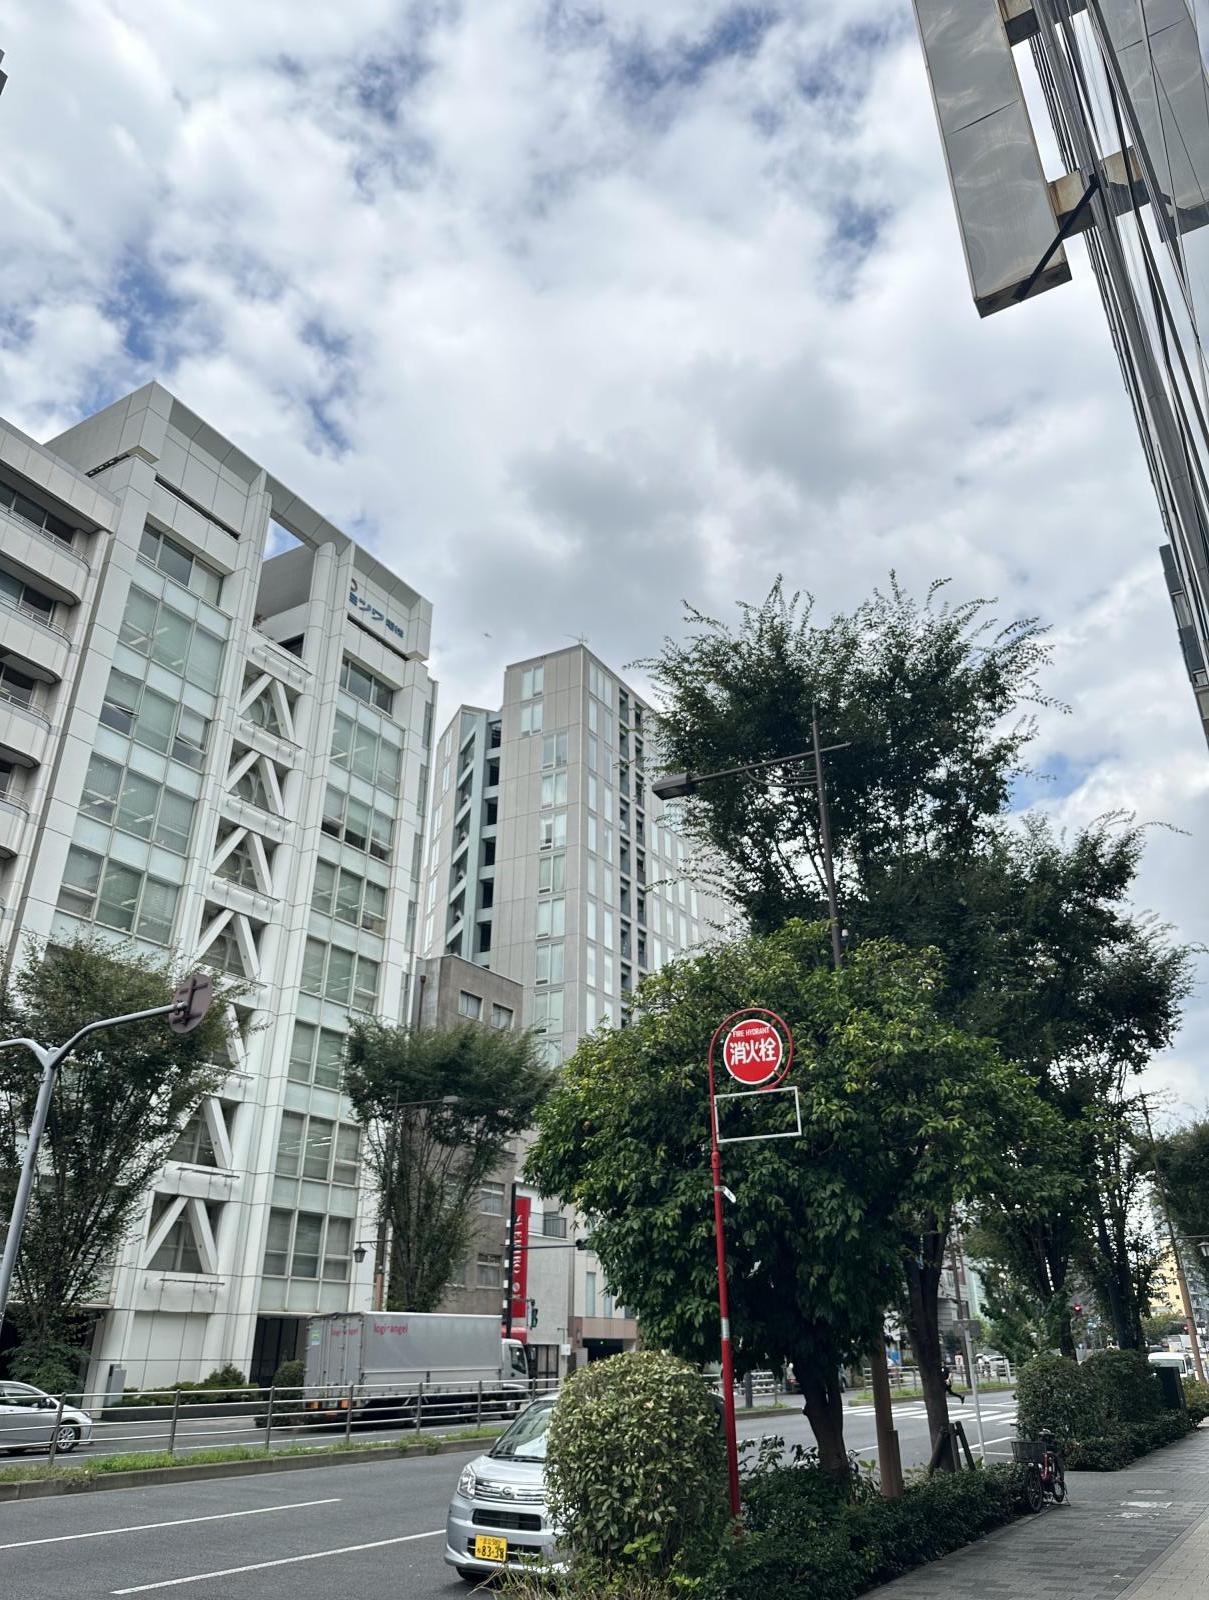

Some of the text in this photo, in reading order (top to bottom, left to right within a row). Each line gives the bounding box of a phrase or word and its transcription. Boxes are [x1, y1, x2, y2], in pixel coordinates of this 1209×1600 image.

[732, 1026, 770, 1038] FIRE HYDRANT
[730, 1037, 777, 1066] 消火栓
